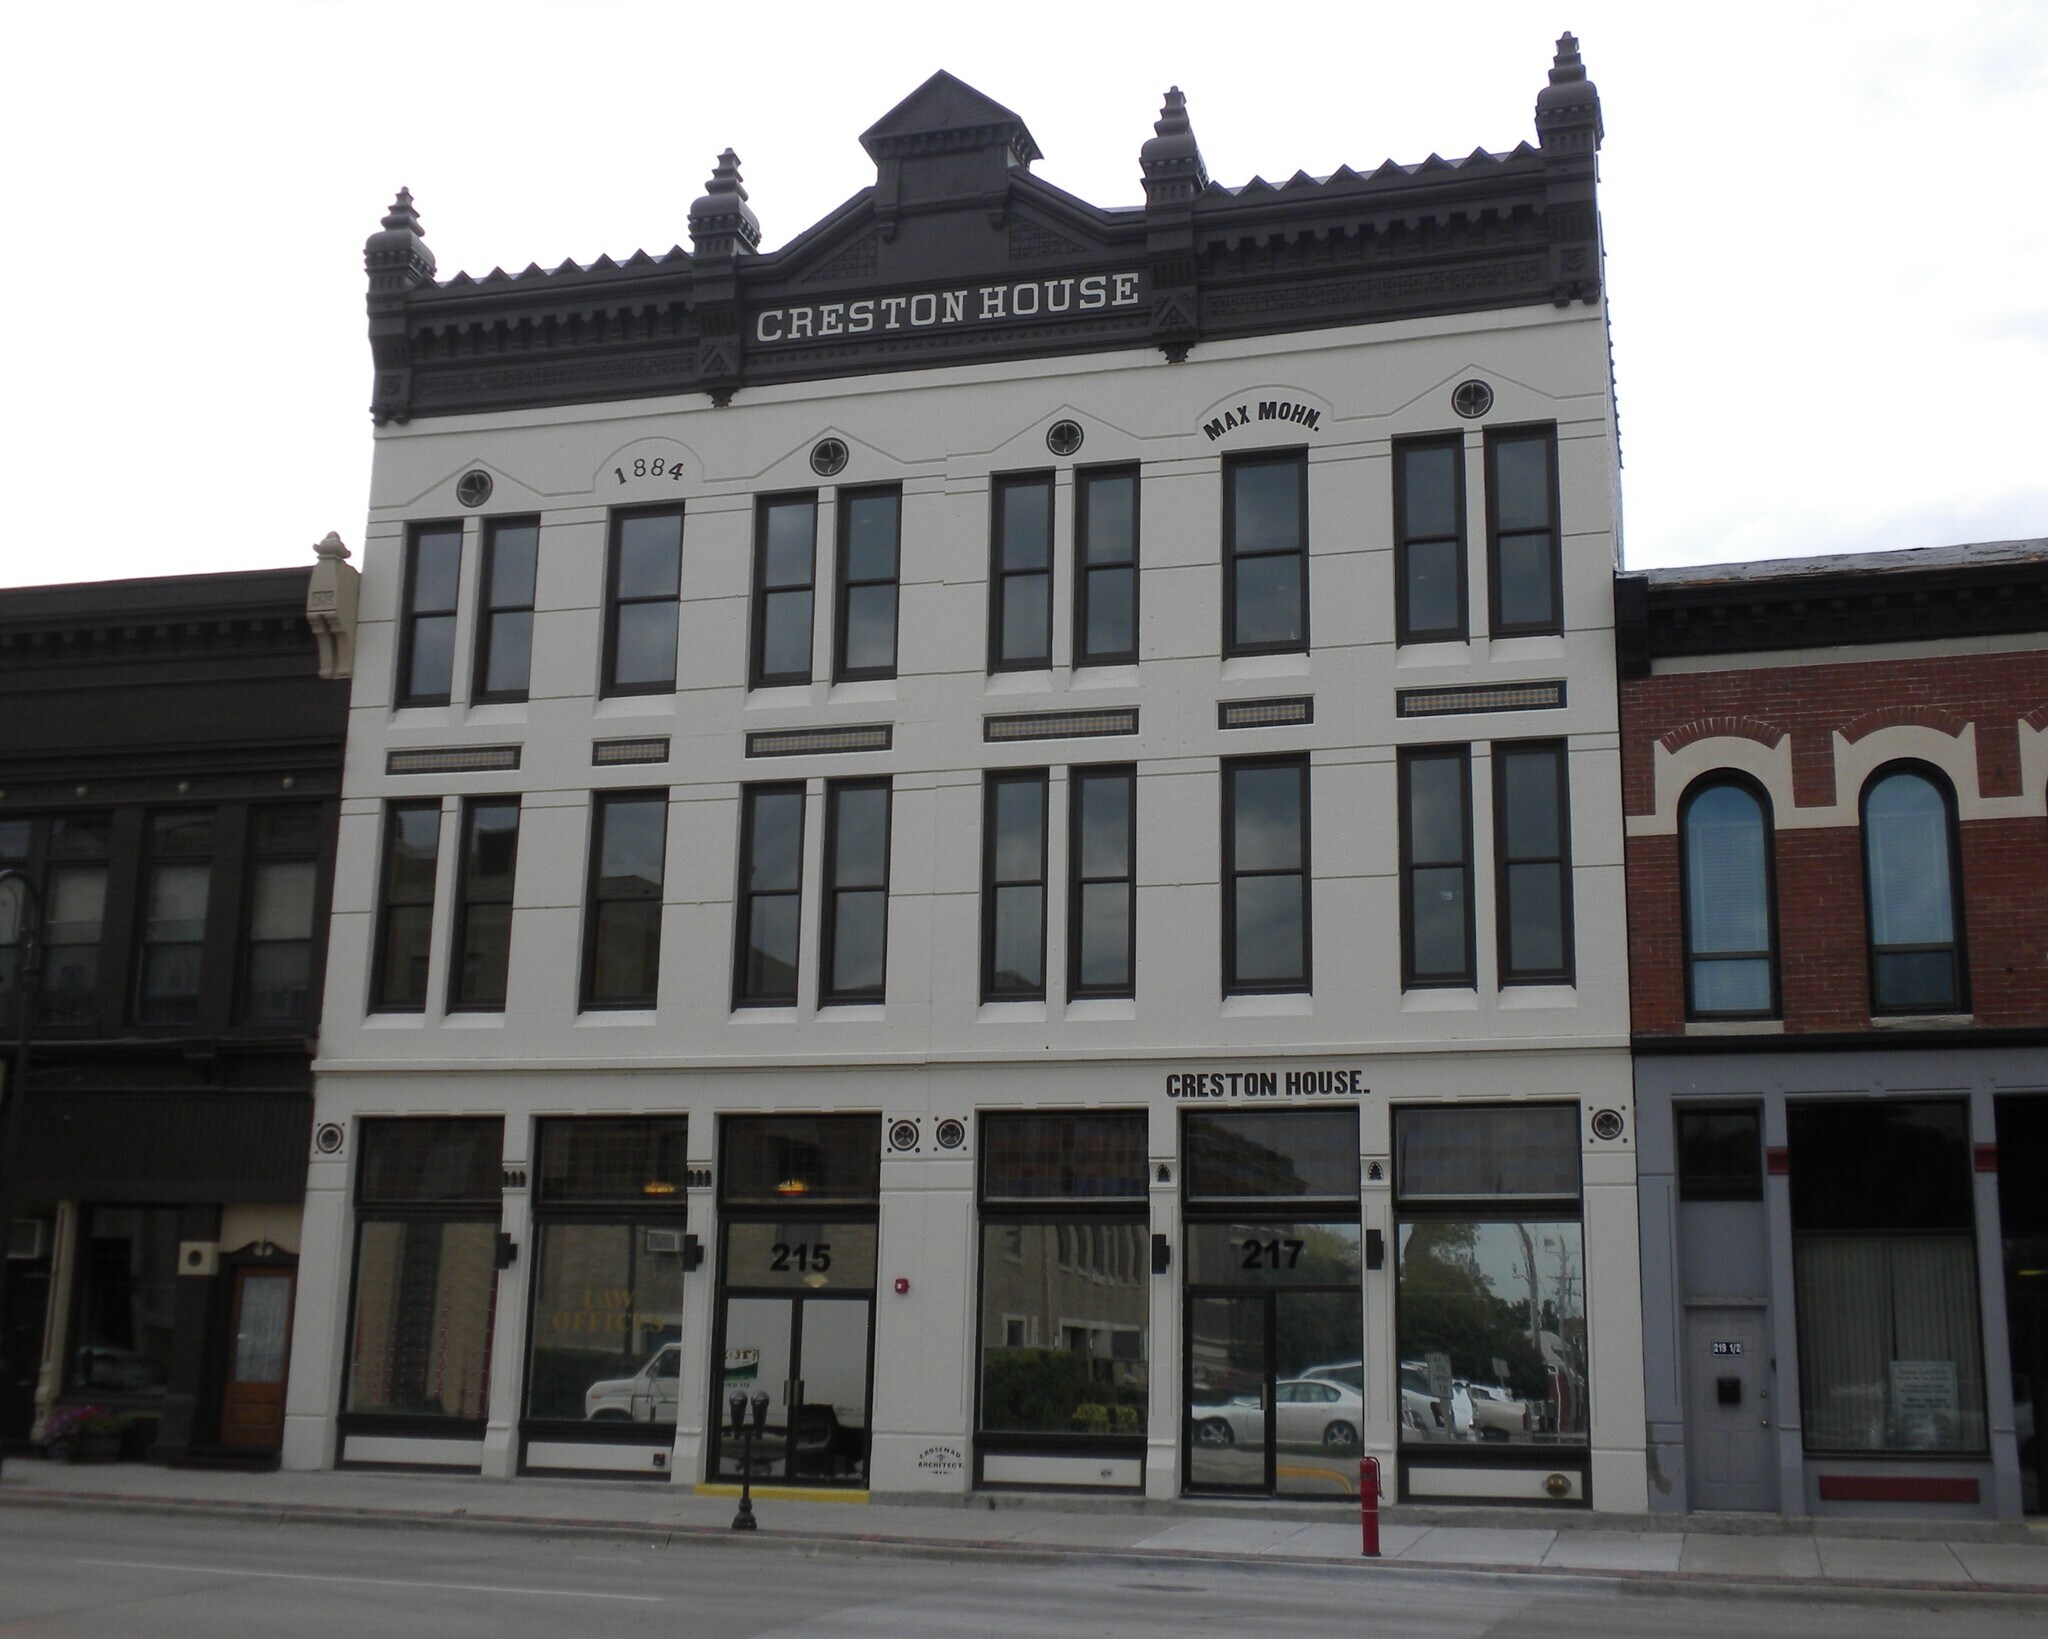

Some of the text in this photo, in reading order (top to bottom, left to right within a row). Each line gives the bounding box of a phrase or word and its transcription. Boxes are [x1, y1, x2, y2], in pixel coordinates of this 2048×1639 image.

[756, 272, 1140, 342] CRESTON HOUSE
[1203, 401, 1321, 441] MAX MOHN.
[614, 457, 685, 485] 1884
[1166, 1070, 1371, 1098] CRESTON HOUSE.
[770, 1243, 831, 1272] 215
[1242, 1239, 1304, 1269] 217
[583, 1288, 634, 1308] LAW
[1713, 1343, 1741, 1354] 219 1/2
